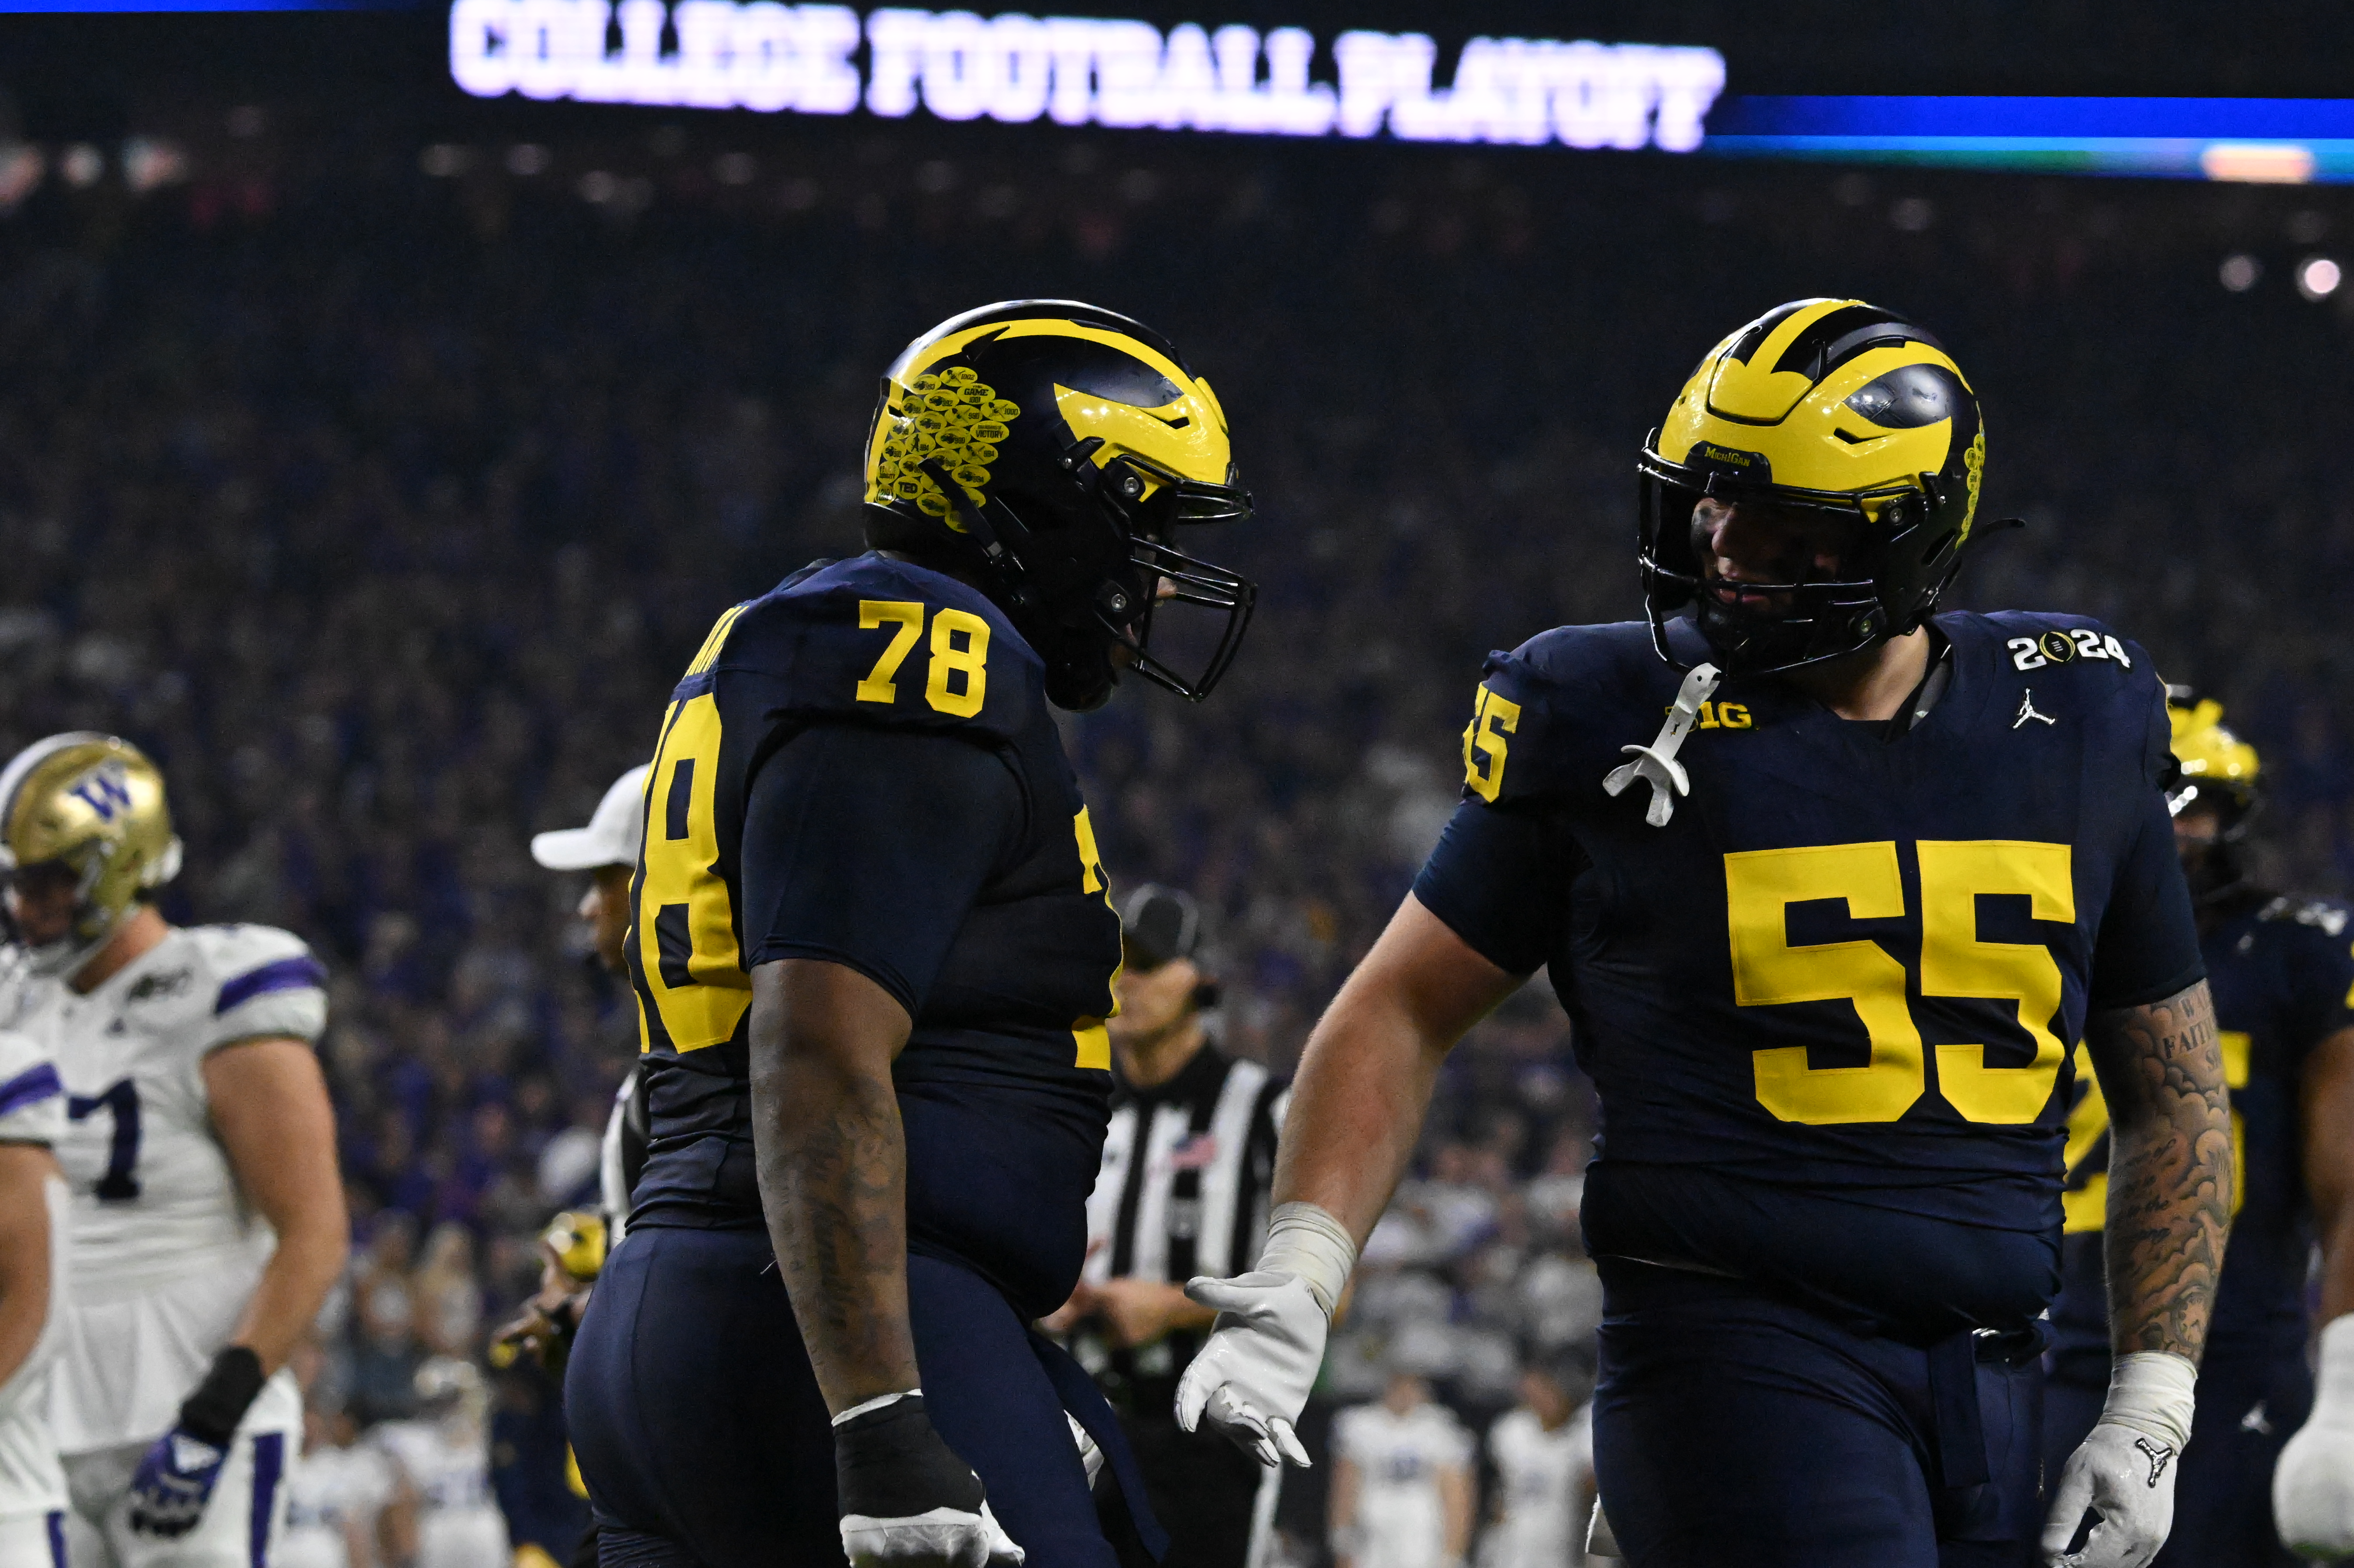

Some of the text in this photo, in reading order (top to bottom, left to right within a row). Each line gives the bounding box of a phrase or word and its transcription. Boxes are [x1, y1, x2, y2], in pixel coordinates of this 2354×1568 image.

[450, 0, 1725, 152] COLLEGE FOOTBALL PLAYOFF
[976, 430, 1004, 438] VICTORY
[856, 600, 990, 718] 78
[2007, 629, 2130, 671] 2024
[623, 692, 753, 1054] 8
[1724, 840, 2075, 1125] 55
